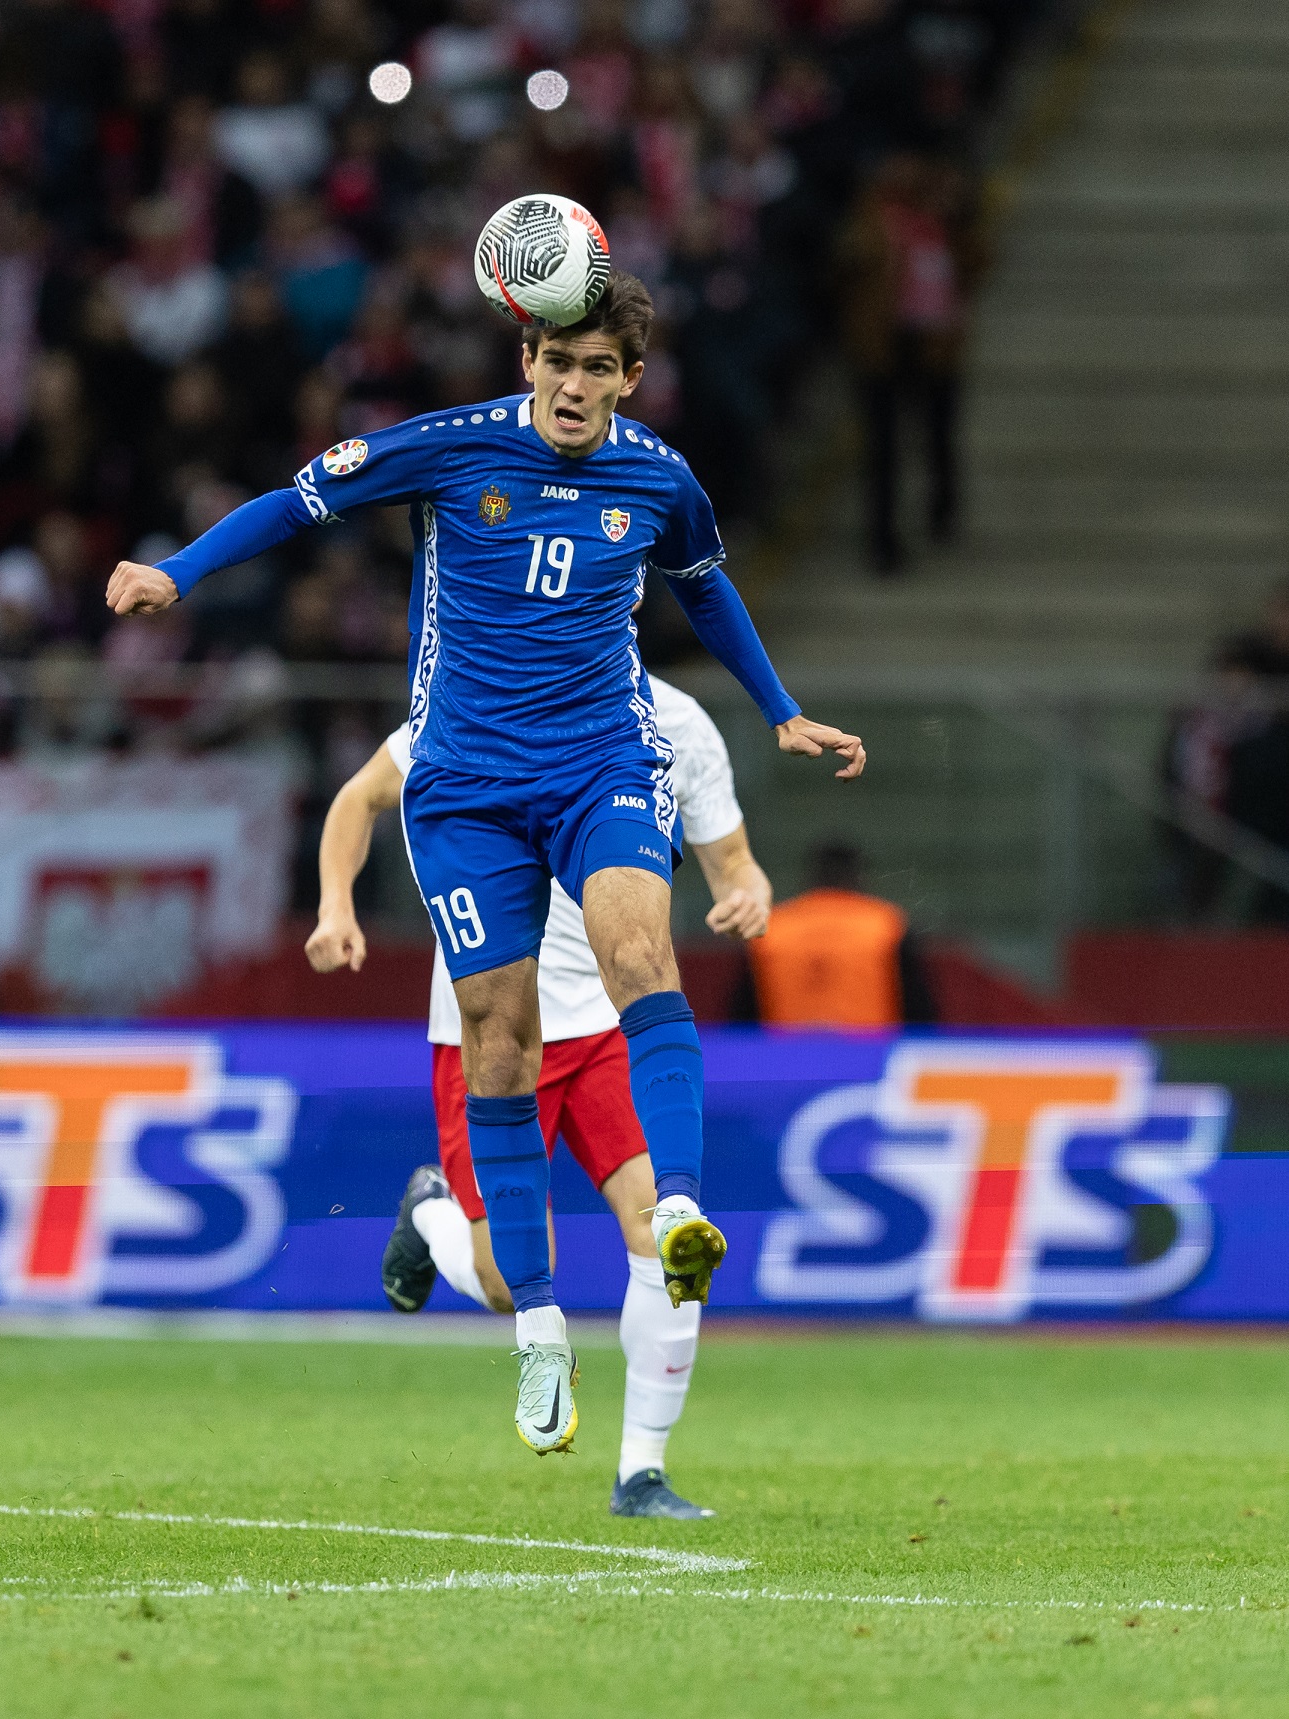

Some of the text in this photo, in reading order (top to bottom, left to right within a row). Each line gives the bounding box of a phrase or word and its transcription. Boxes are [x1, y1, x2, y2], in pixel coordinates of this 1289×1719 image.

[540, 485, 579, 501] JAKO
[525, 534, 575, 599] 19
[612, 795, 647, 810] JAKO
[637, 845, 666, 865] JAKO
[430, 887, 486, 954] 19
[642, 1072, 693, 1096] JAKO
[757, 1040, 1228, 1320] STS
[485, 1187, 523, 1201] AKO
